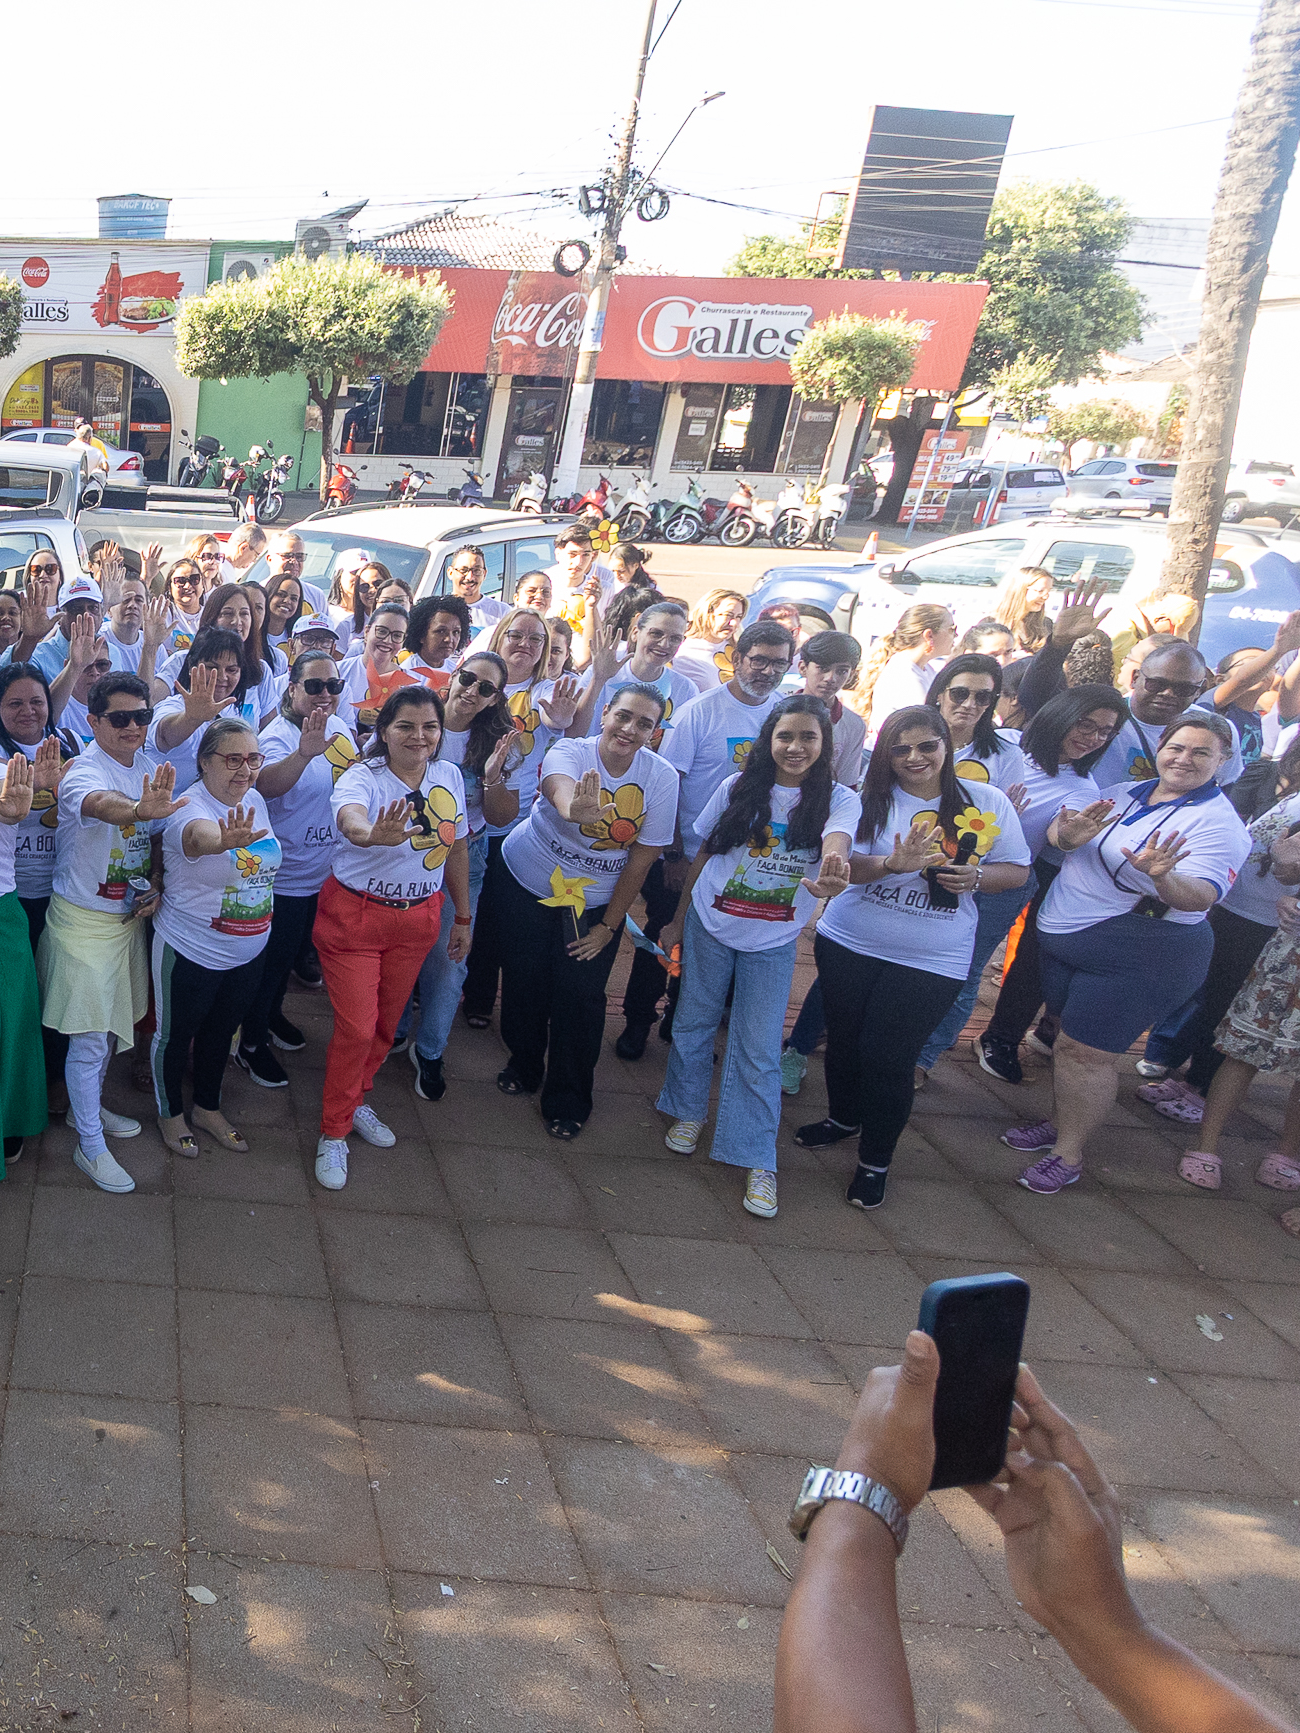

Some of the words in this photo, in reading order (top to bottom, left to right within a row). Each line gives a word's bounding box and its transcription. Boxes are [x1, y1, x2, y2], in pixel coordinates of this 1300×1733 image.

[23, 303, 69, 320] alles
[491, 290, 592, 348] Coca-Col
[700, 306, 751, 315] Churrascaria
[760, 308, 809, 317] Restaurante
[641, 298, 808, 355] Galles
[927, 437, 957, 450] Glles
[305, 825, 333, 842] FAÇA
[757, 860, 777, 871] FAÇA
[778, 863, 805, 874] BONITO
[366, 878, 402, 898] FAÇA
[894, 905, 918, 916] CRIANÇAS
